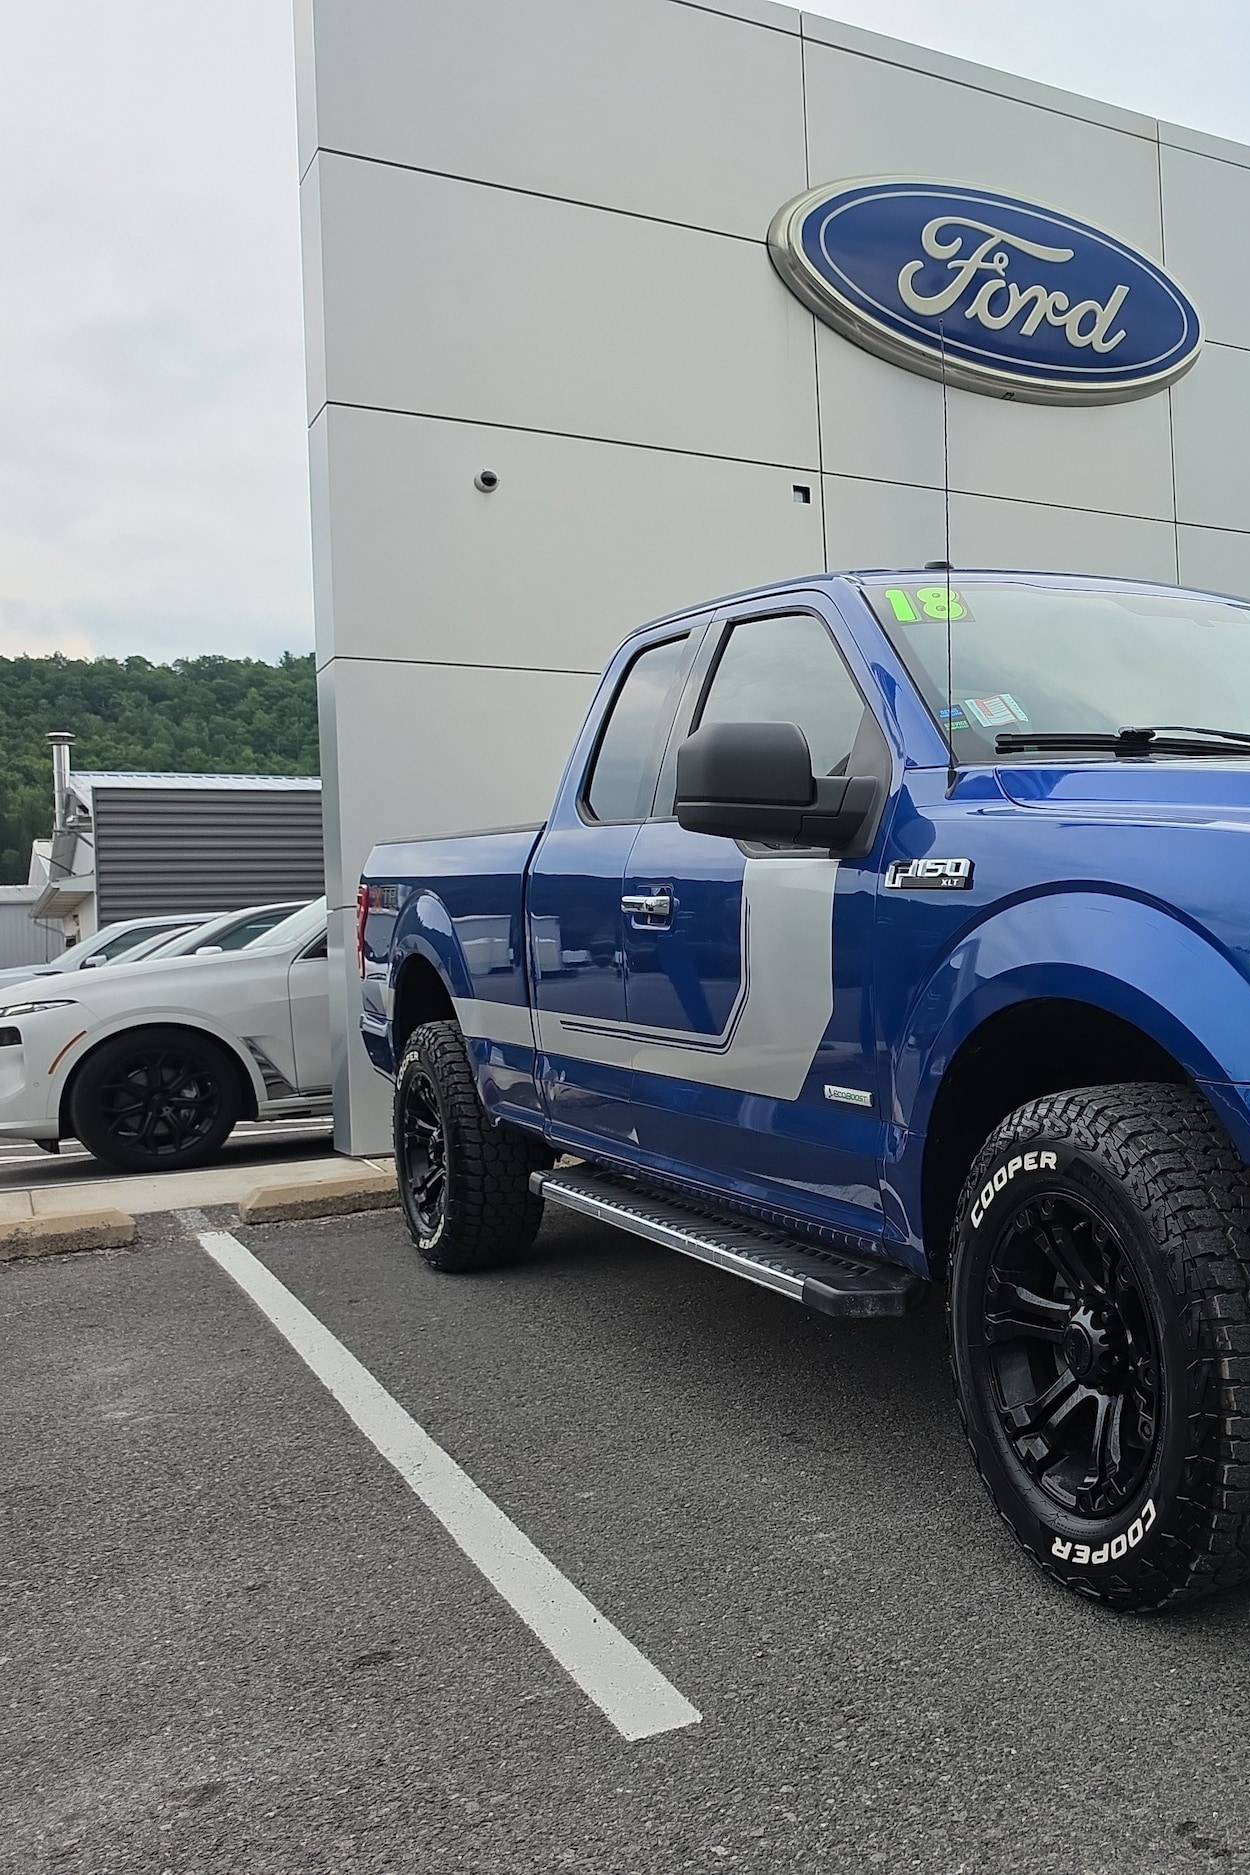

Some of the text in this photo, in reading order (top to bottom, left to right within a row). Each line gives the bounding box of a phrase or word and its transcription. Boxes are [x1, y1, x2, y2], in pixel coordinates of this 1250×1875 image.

[898, 216, 1130, 354] Ford
[884, 587, 966, 622] 18
[941, 878, 959, 886] XLT
[970, 1151, 1058, 1229] COOPER
[1051, 1498, 1157, 1565] COOPER
